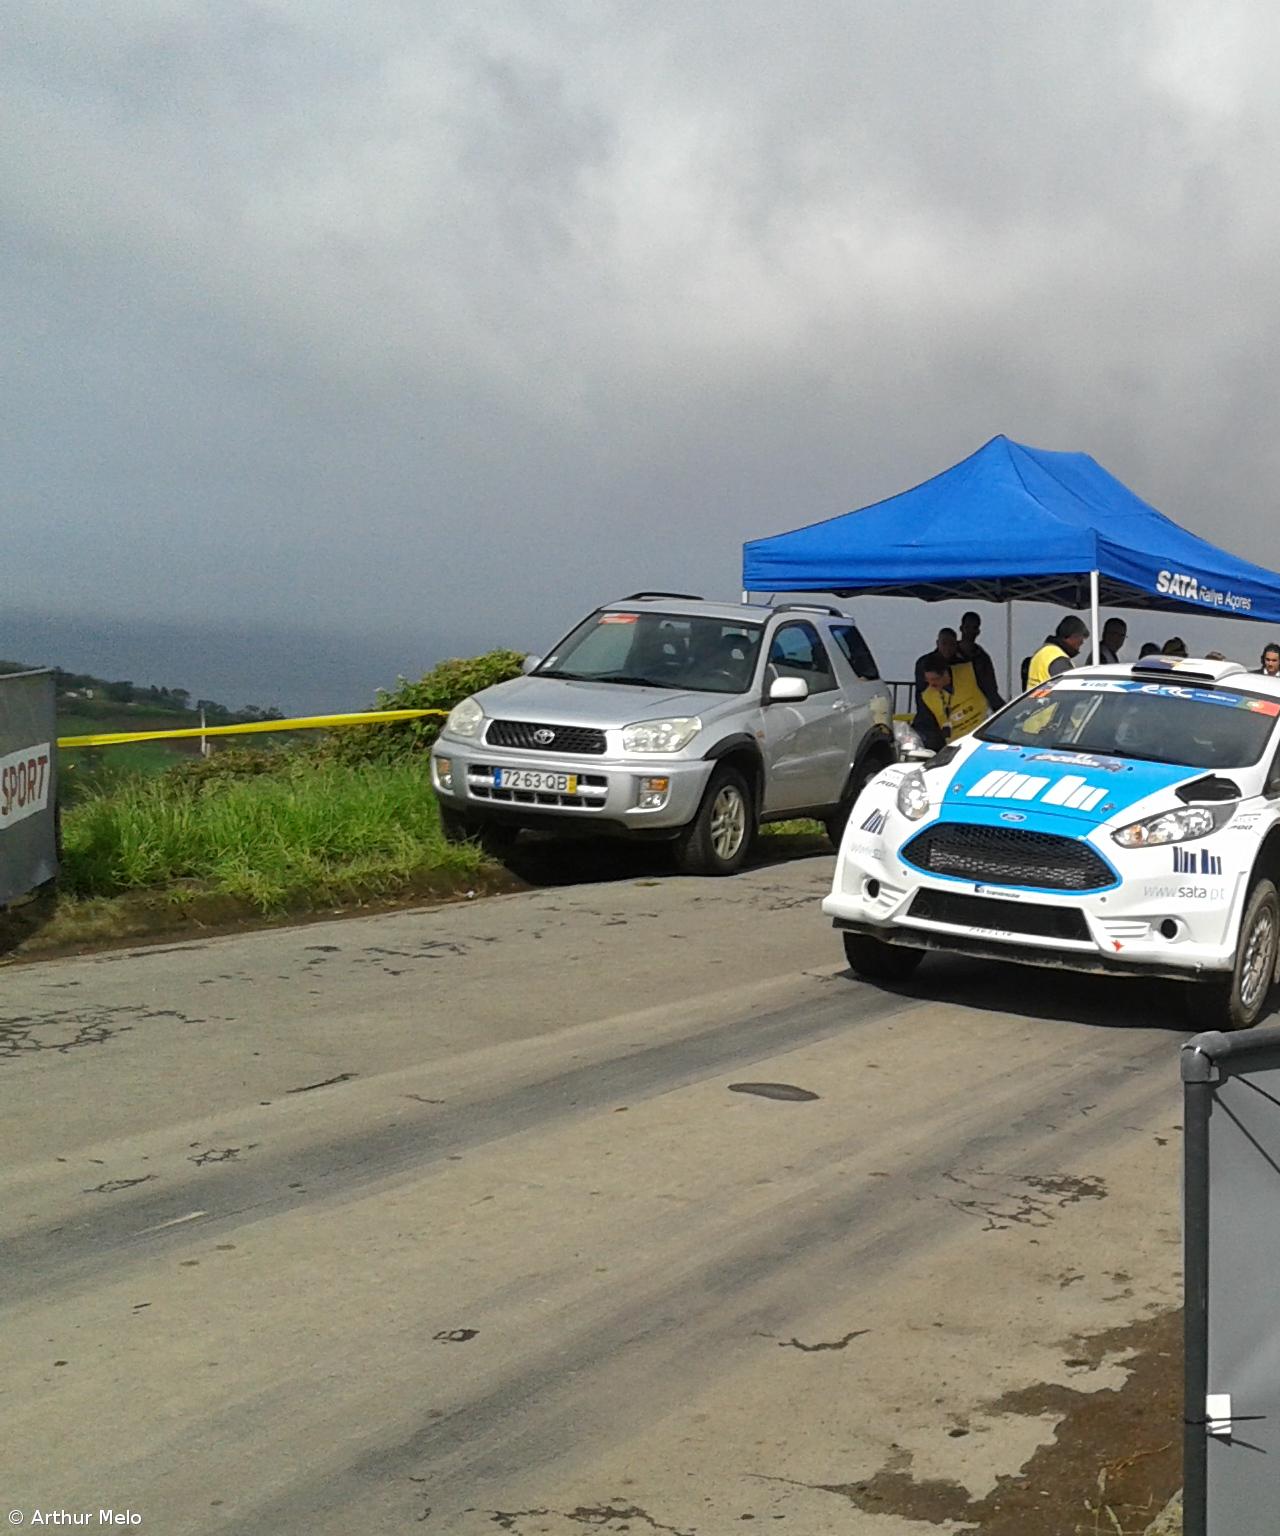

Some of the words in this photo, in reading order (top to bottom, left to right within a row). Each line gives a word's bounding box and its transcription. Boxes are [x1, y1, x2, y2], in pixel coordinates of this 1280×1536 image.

[1156, 570, 1198, 600] SATA
[1200, 585, 1223, 606] Rallye
[1224, 590, 1252, 610] Açores
[1, 754, 48, 816] SPORT
[503, 770, 567, 791] 72-63-QB
[1143, 885, 1225, 902] wwwsatapt
